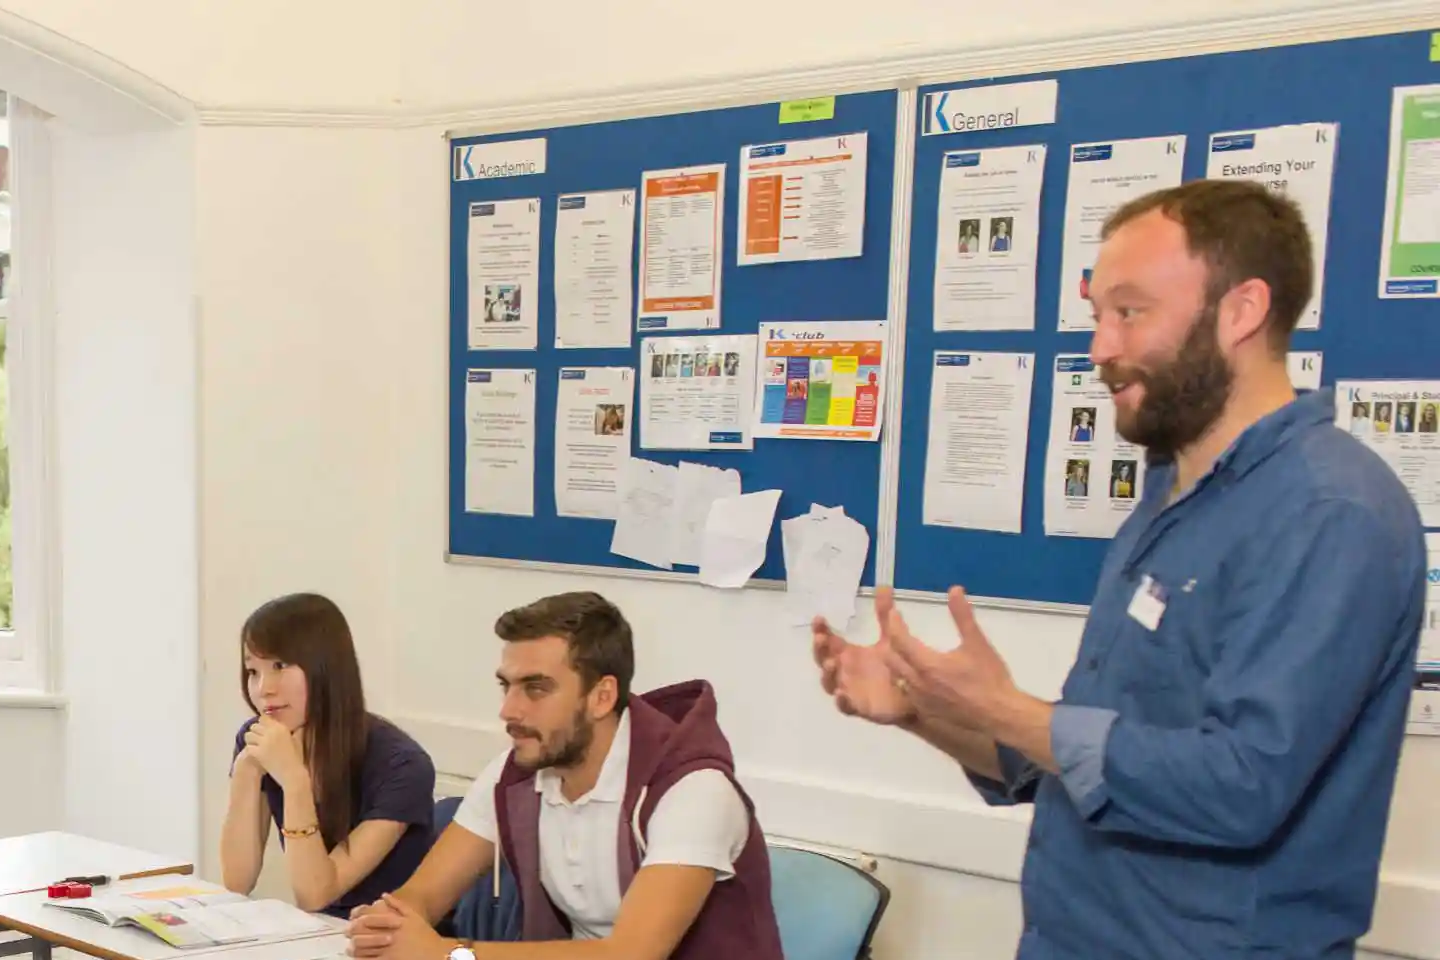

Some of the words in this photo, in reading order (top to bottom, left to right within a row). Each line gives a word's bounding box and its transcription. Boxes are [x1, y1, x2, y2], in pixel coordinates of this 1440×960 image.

[952, 106, 1019, 131] General
[479, 160, 536, 177] Academic
[1222, 161, 1282, 176] Extending
[1286, 159, 1316, 172] Your
